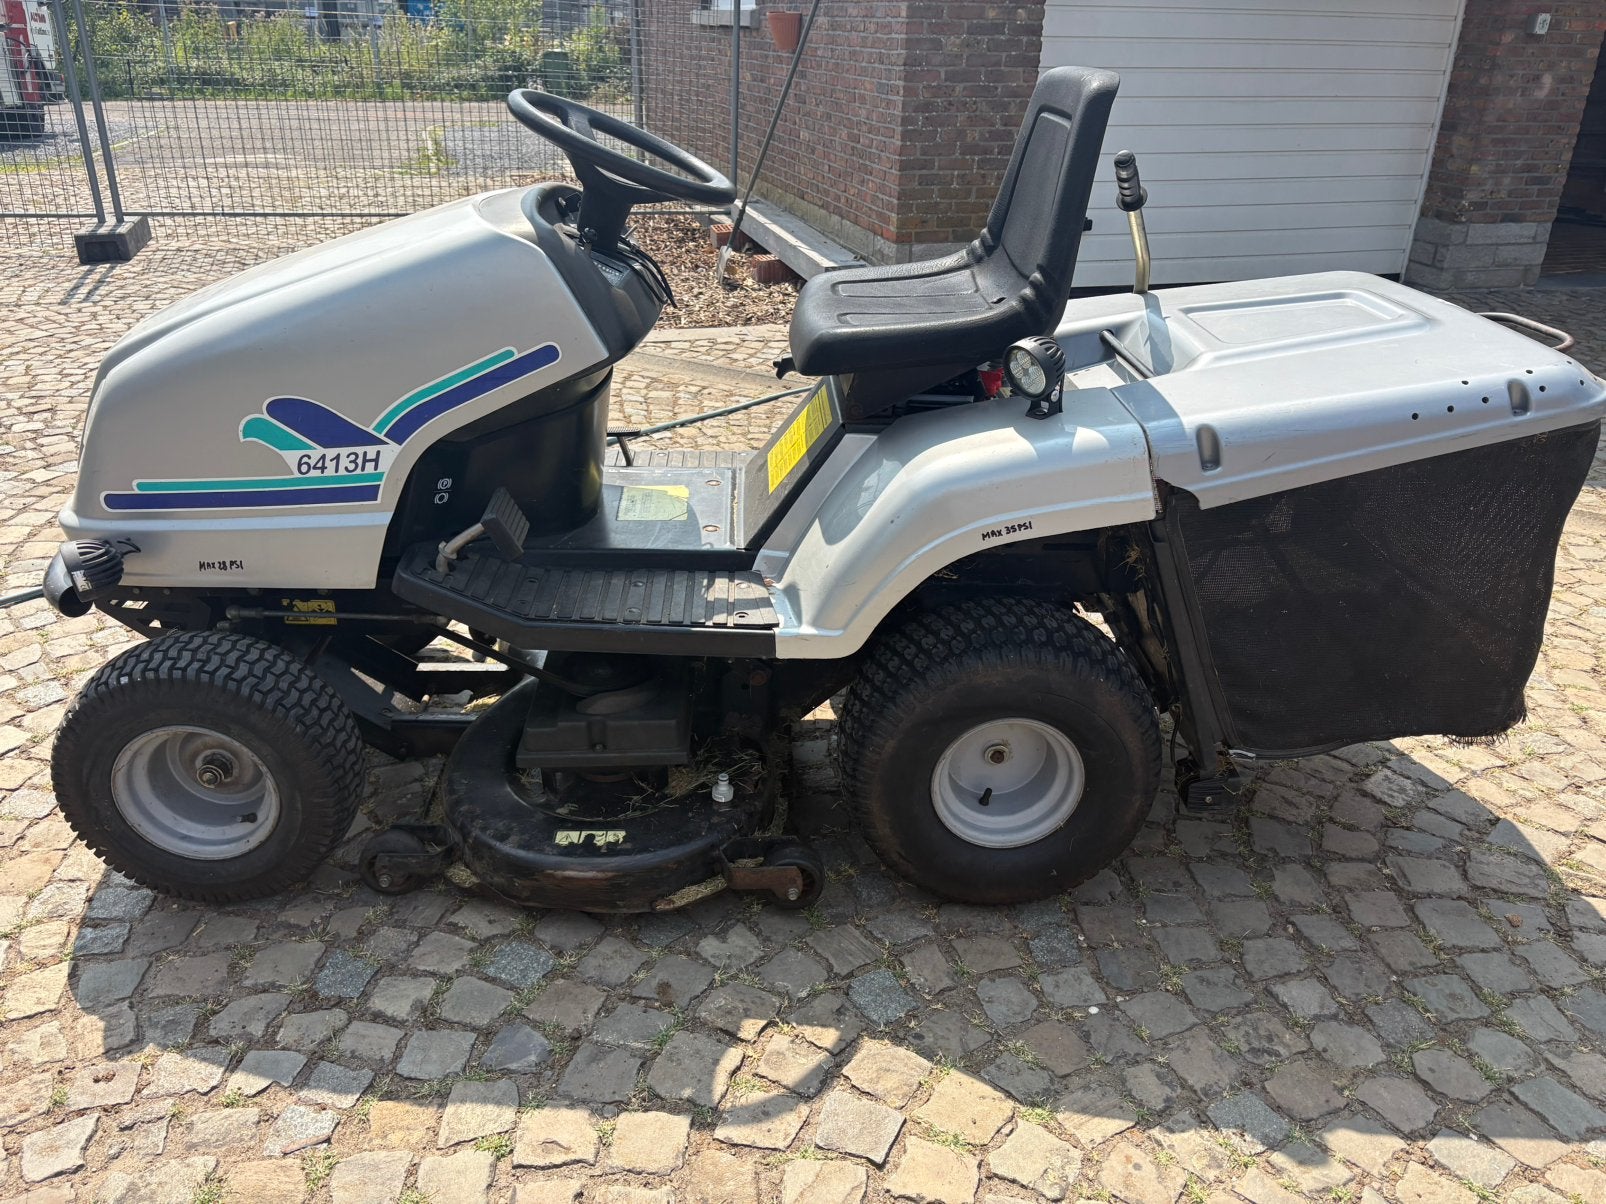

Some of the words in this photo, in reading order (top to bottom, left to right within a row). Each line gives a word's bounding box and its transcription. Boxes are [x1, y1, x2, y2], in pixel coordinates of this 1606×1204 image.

[297, 449, 381, 476] 6413H
[981, 529, 1003, 541] MAX
[198, 560, 217, 572] MAX
[217, 560, 228, 571] 28
[229, 559, 244, 571] PSI
